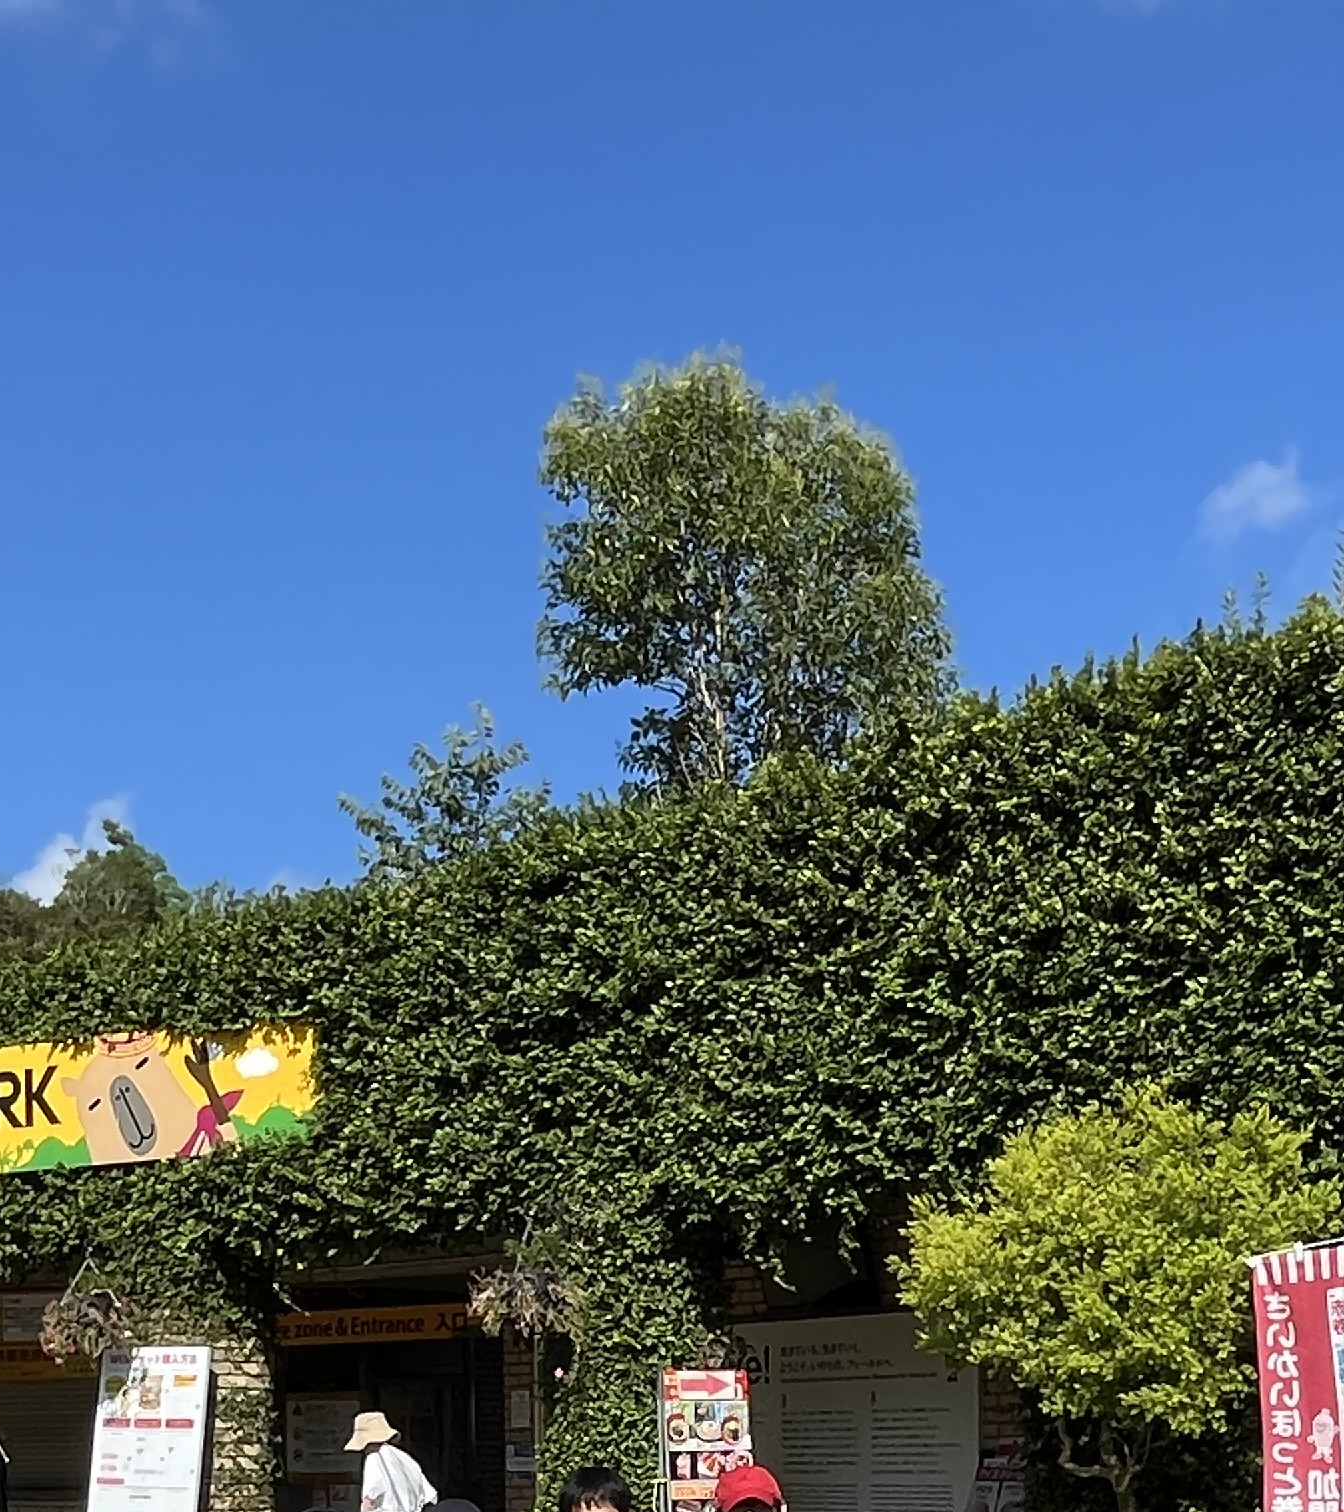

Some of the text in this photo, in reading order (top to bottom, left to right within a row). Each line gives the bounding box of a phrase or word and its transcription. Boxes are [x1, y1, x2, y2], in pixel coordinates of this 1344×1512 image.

[294, 1321, 333, 1339] zone
[351, 1315, 425, 1336] Entrance
[434, 1312, 468, 1332] 入口
